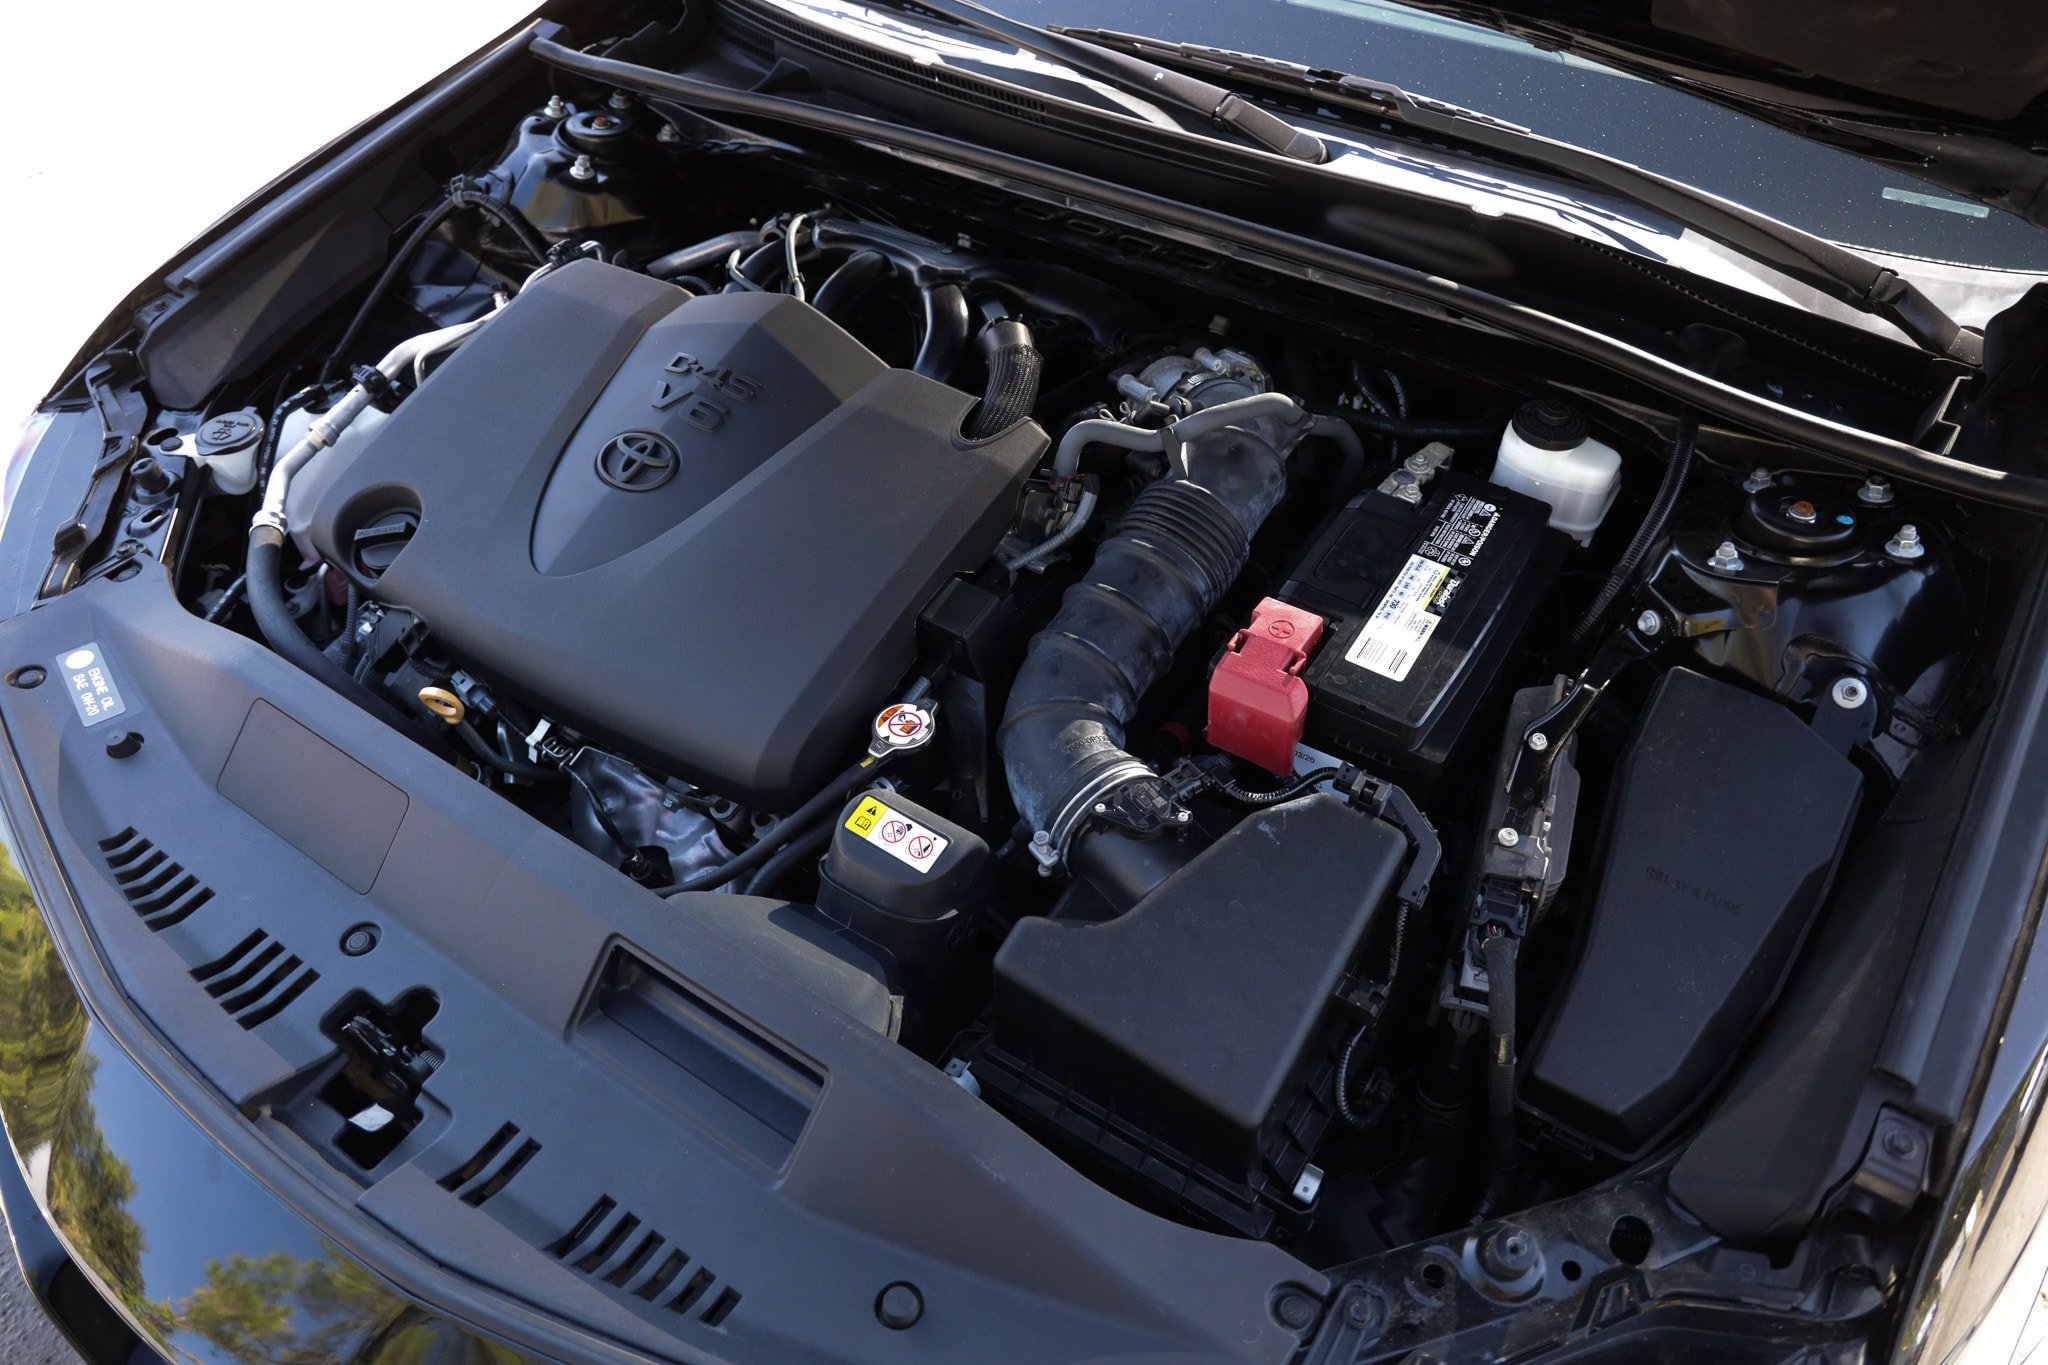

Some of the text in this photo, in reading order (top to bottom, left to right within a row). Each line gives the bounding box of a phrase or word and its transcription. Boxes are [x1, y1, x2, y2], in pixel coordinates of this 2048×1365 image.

[651, 380, 732, 433] V6
[1389, 599, 1401, 610] 730
[1436, 578, 1461, 608] Duralast
[73, 673, 100, 716] SAE 0W-20
[88, 667, 115, 711] ENGINE OIL
